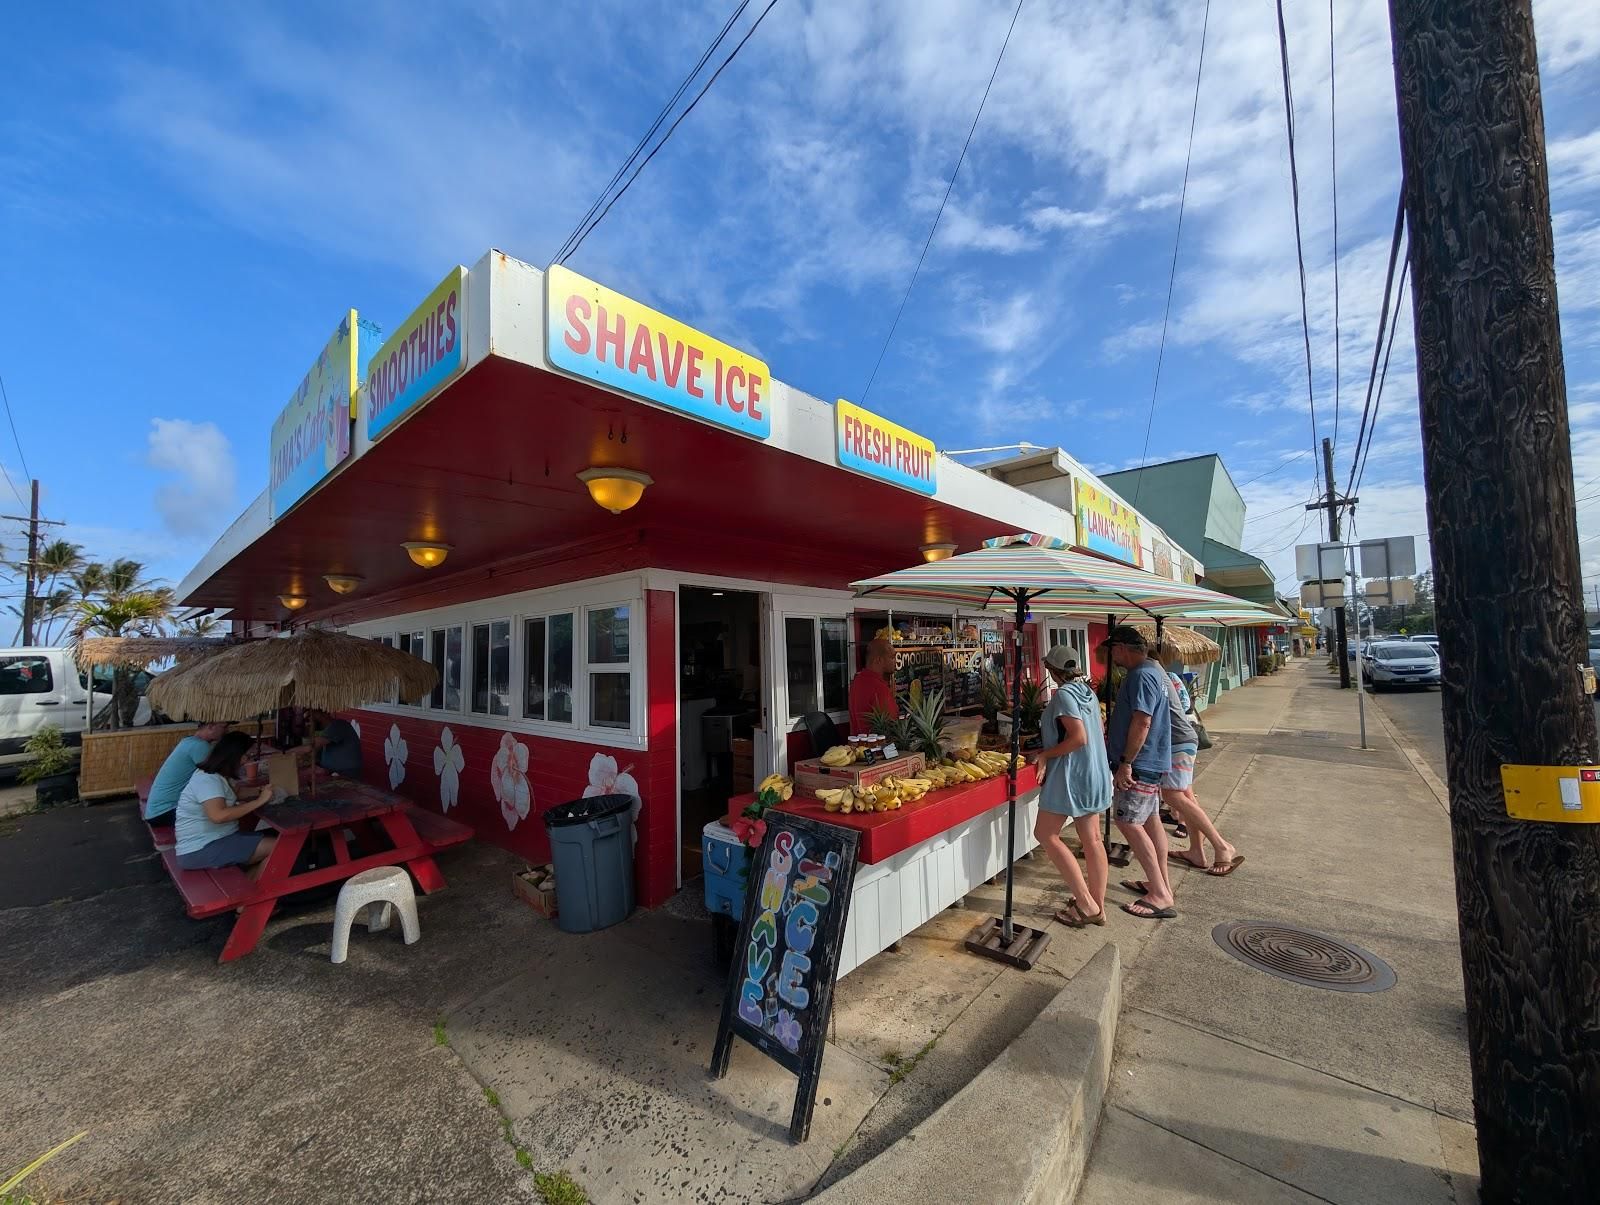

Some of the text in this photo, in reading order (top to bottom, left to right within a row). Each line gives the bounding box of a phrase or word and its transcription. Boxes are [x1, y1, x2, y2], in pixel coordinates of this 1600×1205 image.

[369, 290, 457, 421] SMOOTHIES
[564, 294, 762, 421] SHAVE ICE
[273, 424, 302, 490] LANA'S
[844, 414, 932, 482] FRESH FRUIT
[1088, 507, 1116, 543] LANA'S
[895, 651, 942, 671] SMOOTHIES
[739, 831, 794, 1028] SHAVE
